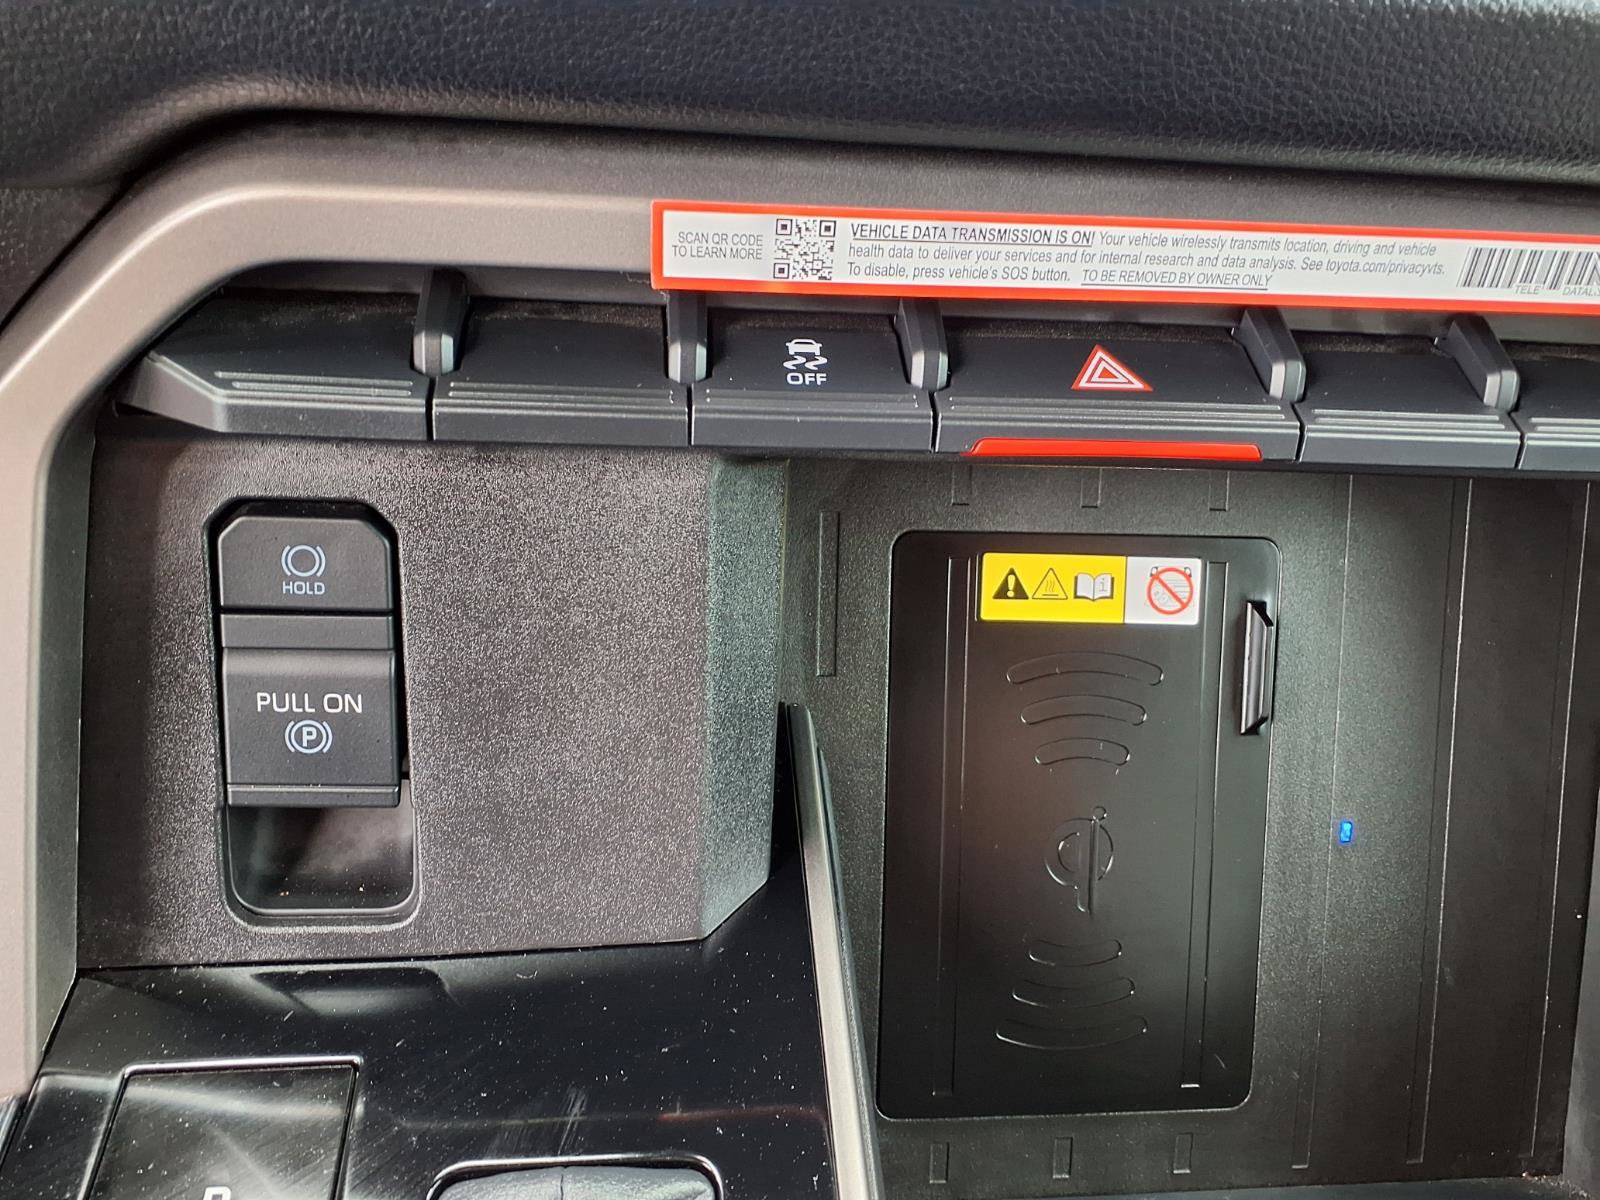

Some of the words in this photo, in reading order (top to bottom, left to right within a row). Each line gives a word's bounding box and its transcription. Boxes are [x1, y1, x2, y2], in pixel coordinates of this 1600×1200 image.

[678, 231, 708, 244] SCAN
[712, 233, 729, 246] QR
[732, 234, 763, 247] CODE
[851, 223, 909, 239] VEHICLE
[913, 226, 946, 240] DATA
[952, 227, 1052, 244] TRANSMISSION
[1056, 230, 1067, 244] IS
[1072, 231, 1095, 245] ON!
[1100, 232, 1125, 246] Your
[1129, 233, 1168, 247] vehicle
[1172, 234, 1227, 252] wirelessly
[1230, 236, 1281, 251] transmits
[1284, 238, 1329, 254] location,
[1334, 240, 1370, 257] driving
[1373, 242, 1396, 255] and
[1399, 243, 1436, 257] vehicle
[672, 245, 687, 258] TO
[690, 245, 727, 258] LEARN
[730, 247, 762, 260] MORE
[849, 243, 884, 258] health
[889, 244, 913, 259] data
[918, 247, 929, 259] to
[934, 245, 972, 260] deliver
[975, 250, 1000, 264] your
[1005, 248, 1051, 263] services
[1056, 250, 1077, 263] and
[1080, 250, 1096, 263] for
[1100, 250, 1142, 265] internal
[1144, 252, 1194, 266] research
[1197, 254, 1219, 267] and
[1221, 254, 1245, 268] data
[1249, 256, 1296, 272] analysis.
[1301, 257, 1323, 270] See
[1326, 258, 1445, 277] toyota.com/privacyvts.
[848, 262, 860, 276] To
[864, 262, 909, 279] disable,
[913, 267, 944, 280] press
[949, 265, 997, 279] vehicle's
[1001, 266, 1028, 280] SOS
[1032, 267, 1070, 281] button.
[1082, 269, 1098, 281] TO
[1101, 270, 1116, 282] BE
[1119, 270, 1176, 284] REMOVED
[1179, 272, 1195, 284] BY
[1197, 273, 1239, 285] OWNER
[1242, 274, 1272, 286] ONLY
[787, 372, 827, 385] OFF
[282, 581, 325, 595] HOLD
[257, 692, 315, 712] PULL
[323, 693, 362, 713] ON
[302, 726, 317, 747] P
